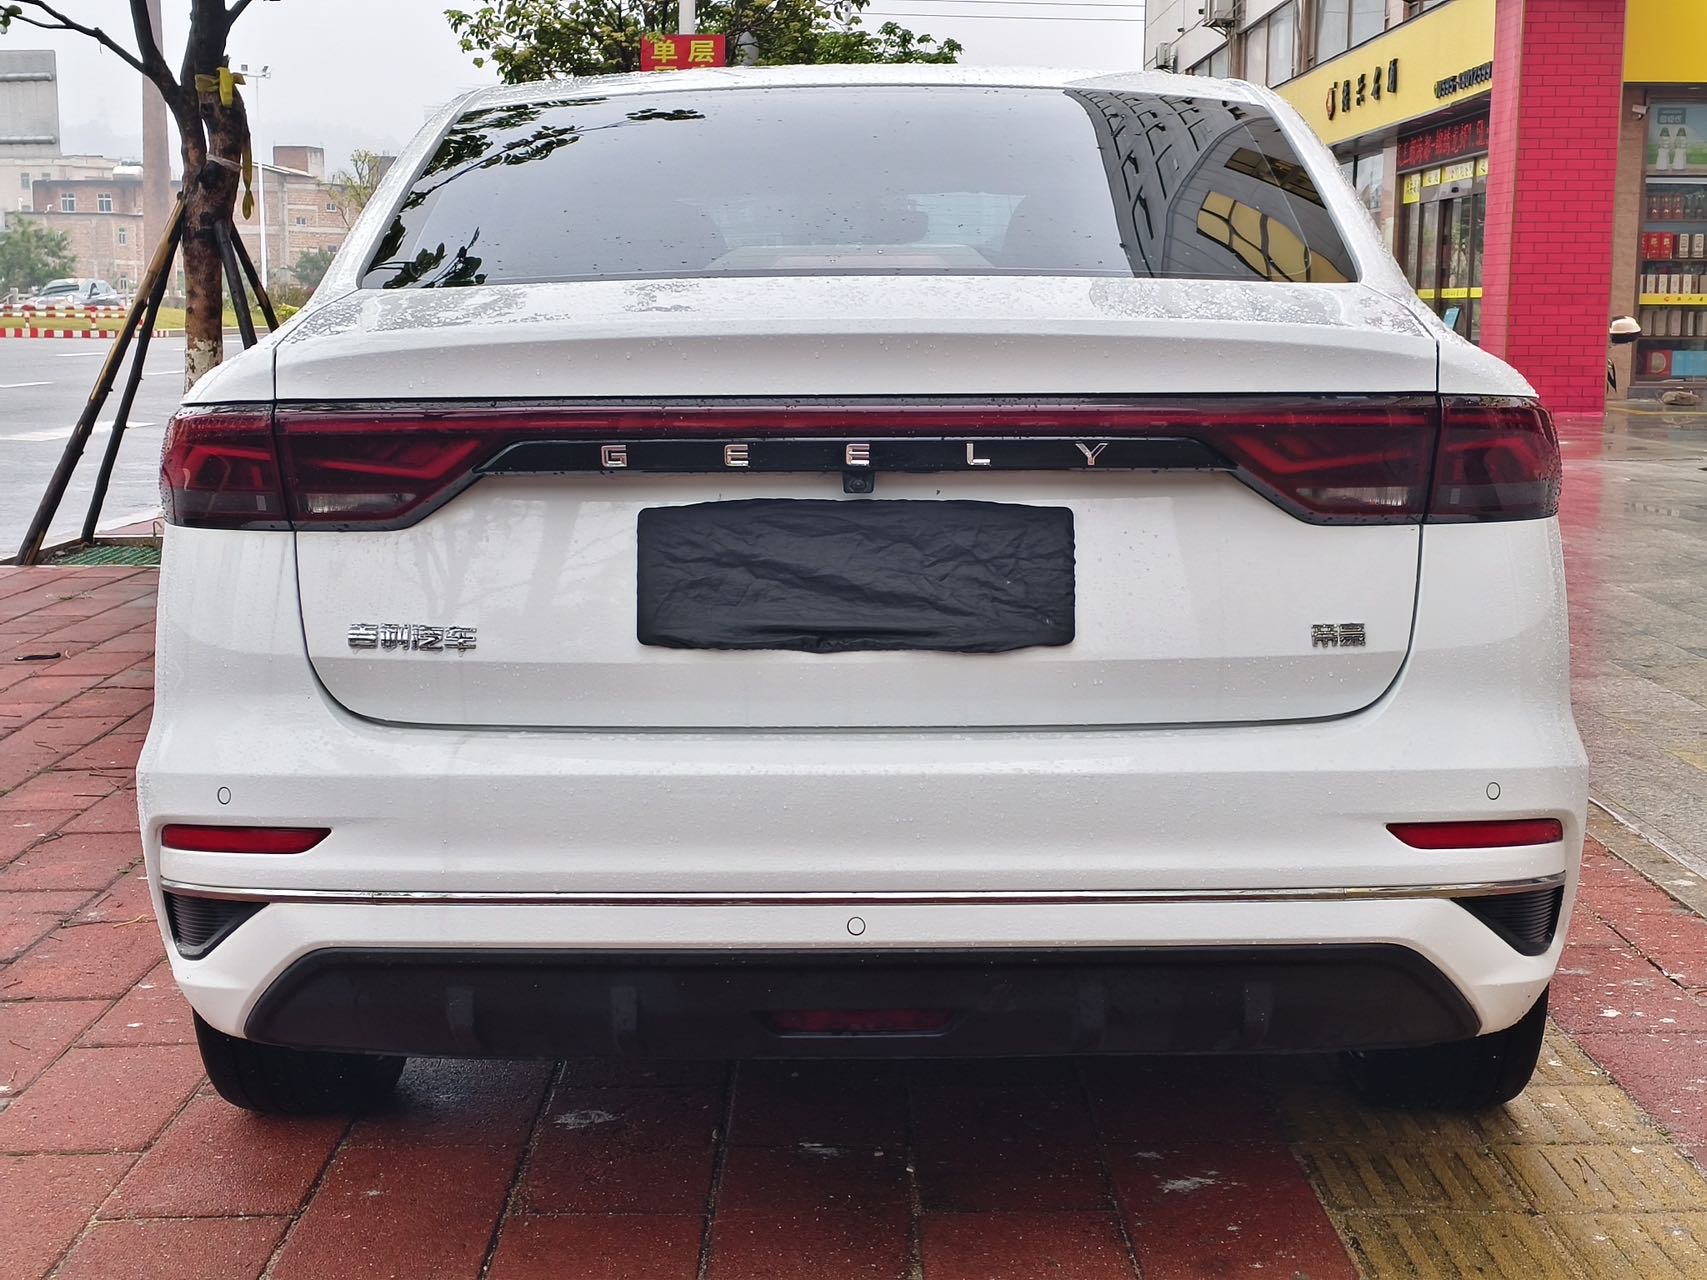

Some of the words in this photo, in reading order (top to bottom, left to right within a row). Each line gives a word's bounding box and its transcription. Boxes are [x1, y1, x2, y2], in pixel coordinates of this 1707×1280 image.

[650, 40, 716, 64] 单层
[601, 442, 1109, 469] GEELY
[348, 623, 477, 652] 吉利汽车
[1311, 623, 1366, 649] 帝豪
